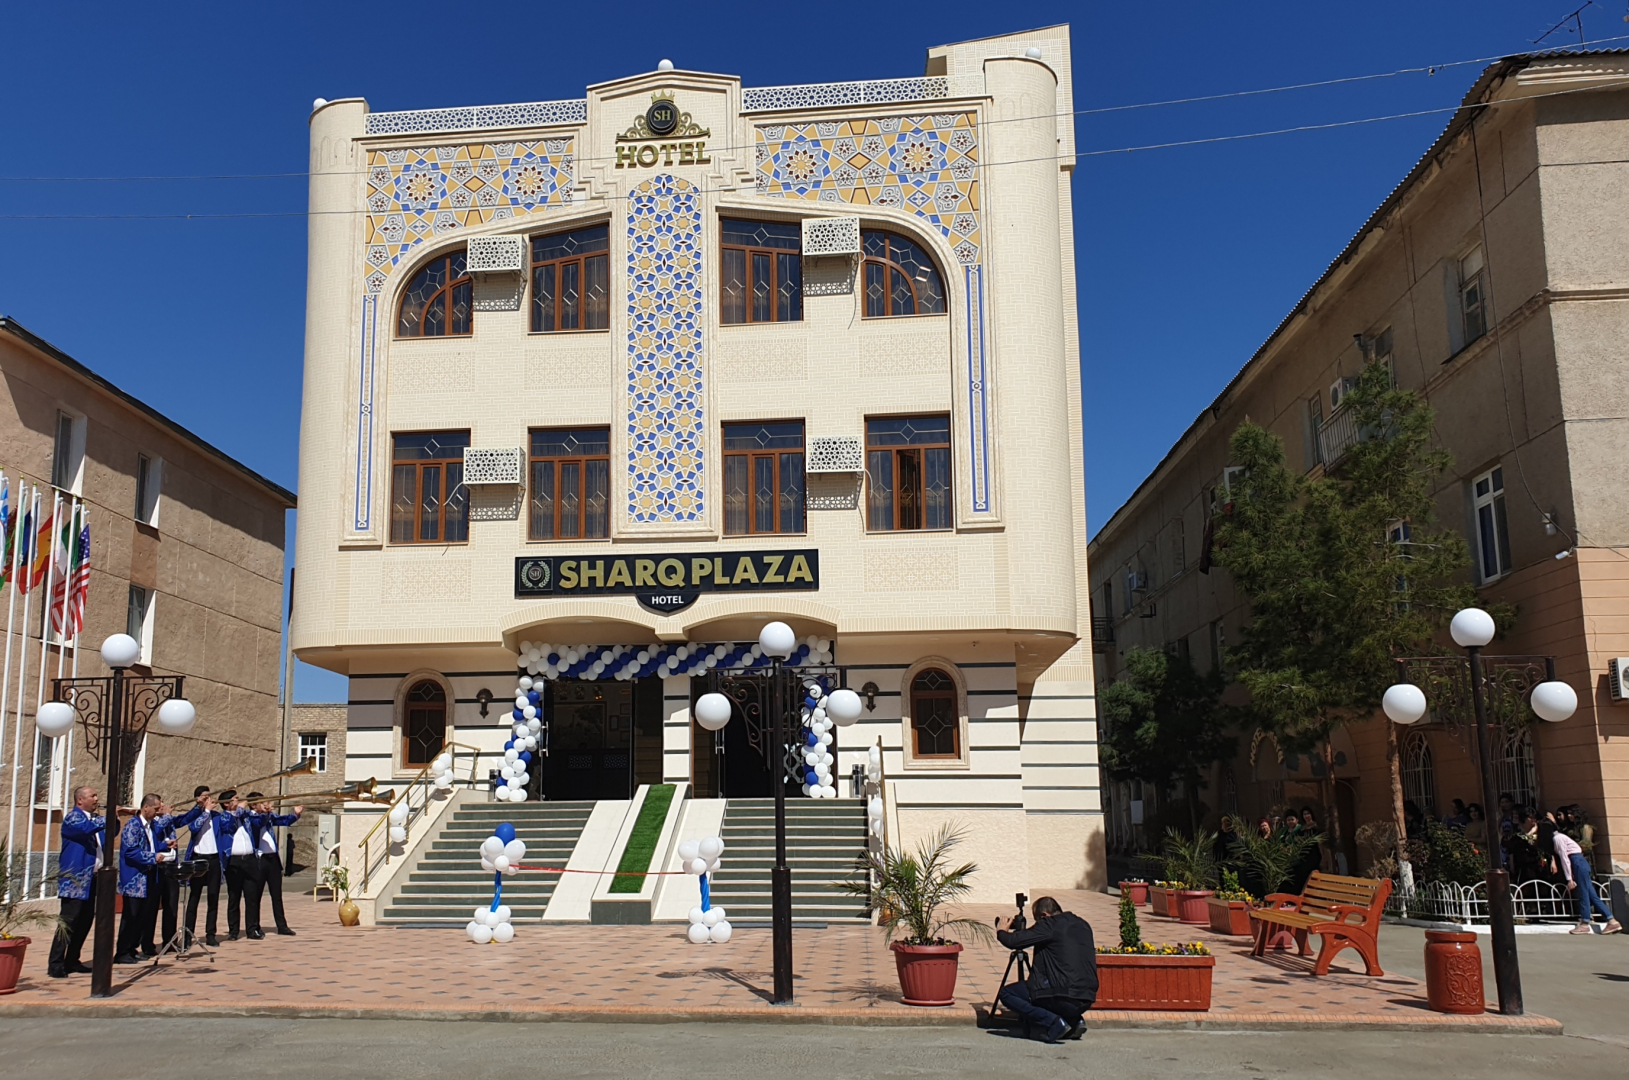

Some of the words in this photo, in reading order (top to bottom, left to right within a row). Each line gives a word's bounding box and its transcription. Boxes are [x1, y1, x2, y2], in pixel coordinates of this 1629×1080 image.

[653, 110, 671, 121] SH
[615, 142, 711, 168] HOTEL
[559, 559, 686, 588] SHARQ
[692, 555, 814, 585] PLAZA
[651, 595, 684, 605] HOTEL
